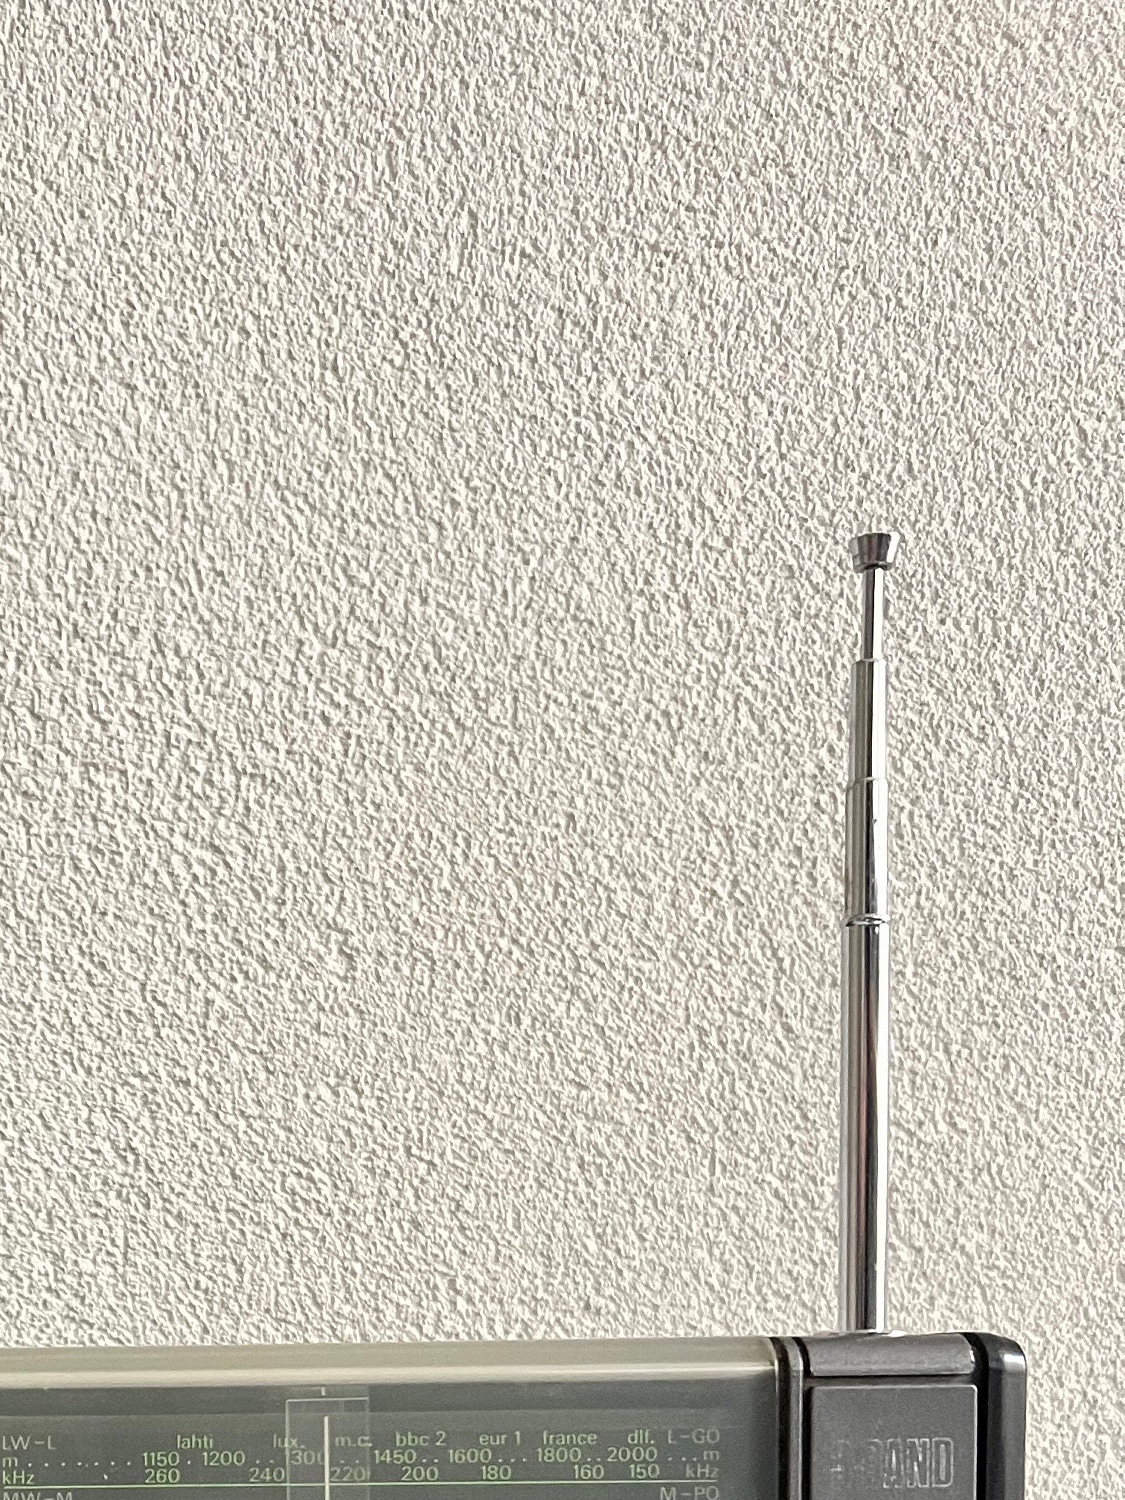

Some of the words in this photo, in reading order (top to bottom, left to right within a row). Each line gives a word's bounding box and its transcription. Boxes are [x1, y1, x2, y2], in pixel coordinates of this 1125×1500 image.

[177, 1433, 213, 1449] lahti
[396, 1431, 429, 1447] bbc
[435, 1431, 446, 1446] 2
[479, 1433, 507, 1445] eur
[543, 1430, 597, 1445] france
[2, 1456, 18, 1467] m
[142, 1451, 179, 1467] 1150
[202, 1451, 245, 1466] 1200
[284, 1450, 325, 1465] 300
[375, 1449, 416, 1464] 1450
[449, 1448, 492, 1463] 1600
[537, 1447, 581, 1462] 1800
[607, 1447, 657, 1462] 2000
[704, 1450, 719, 1461] m
[2, 1470, 34, 1484] kHz
[145, 1468, 180, 1483] 260
[249, 1467, 285, 1482] 240
[330, 1466, 366, 1481] 220
[401, 1466, 438, 1481] 200
[481, 1465, 511, 1480] 180
[575, 1464, 604, 1479] 160
[629, 1463, 660, 1479] 150
[686, 1463, 719, 1478] kHz
